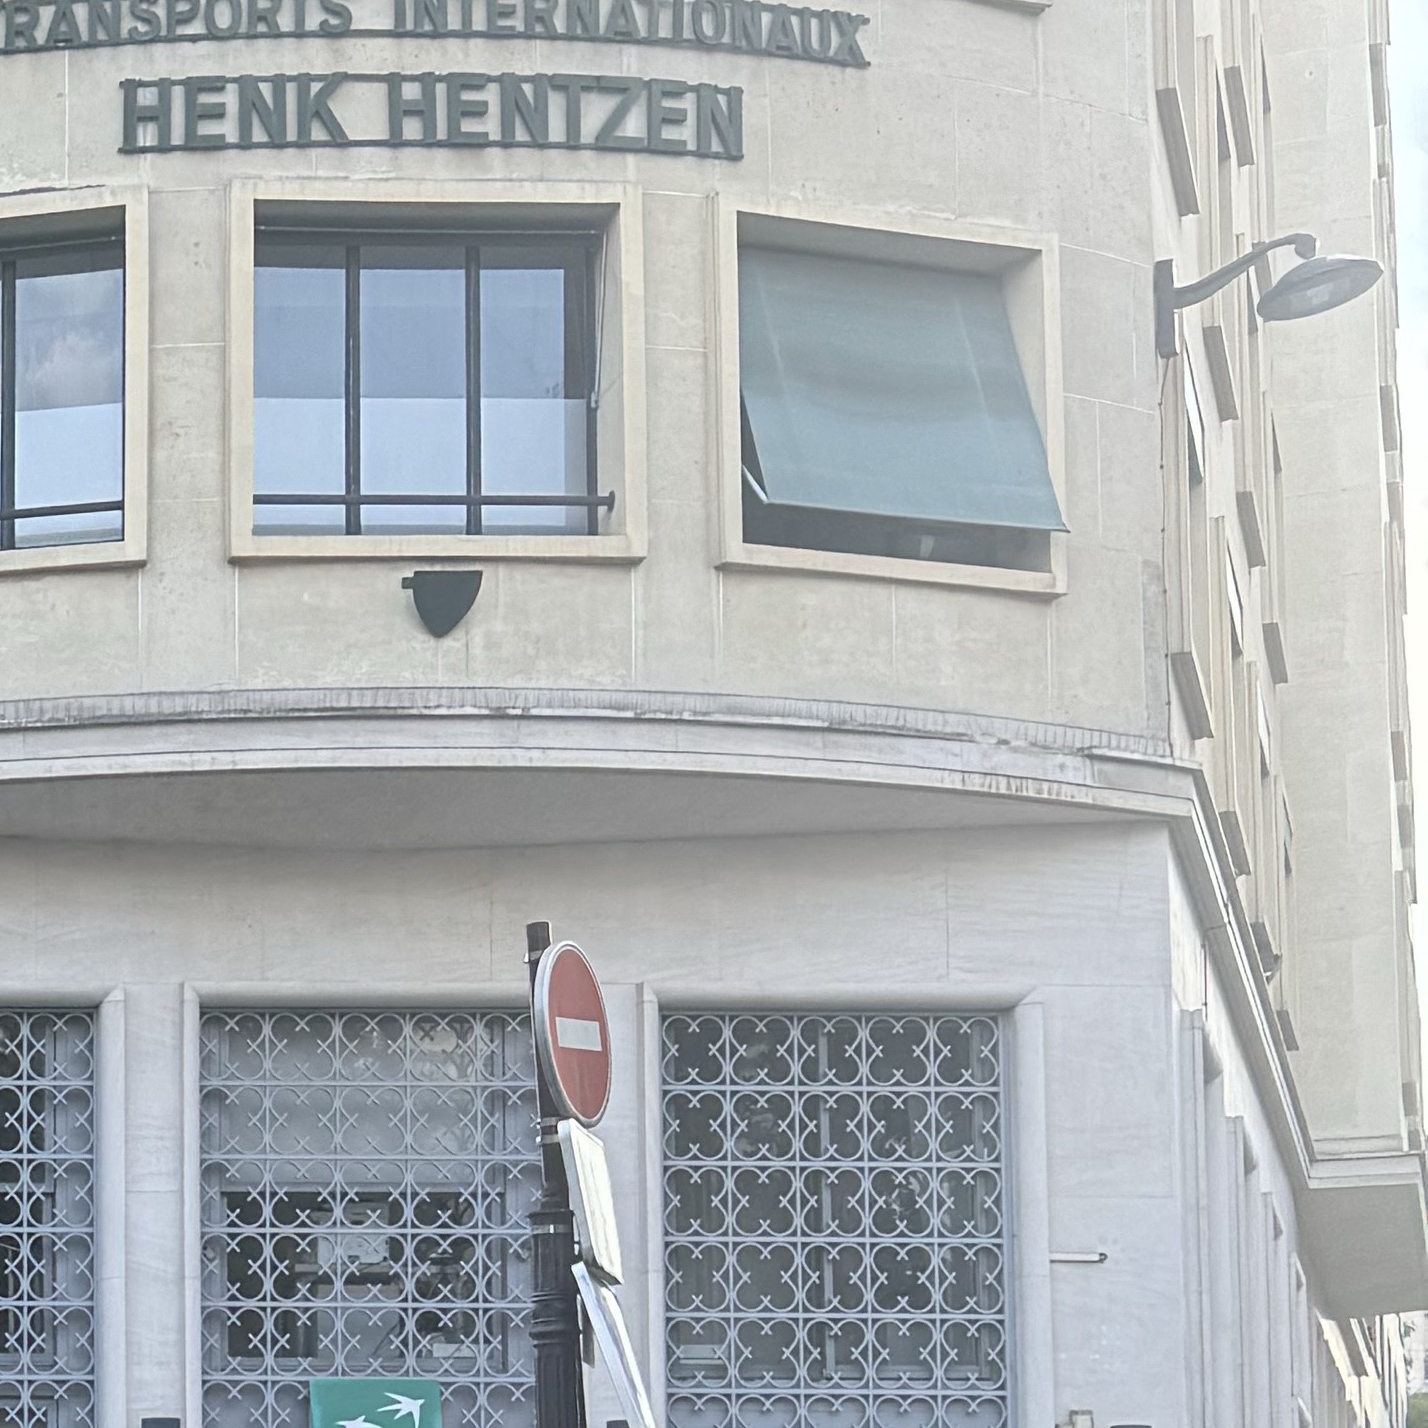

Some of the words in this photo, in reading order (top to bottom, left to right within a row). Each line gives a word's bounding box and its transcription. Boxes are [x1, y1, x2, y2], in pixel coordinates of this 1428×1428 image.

[395, 0, 868, 66] INTERNATIONAUX
[122, 72, 349, 151] HENK
[388, 72, 744, 160] HENTZEN
